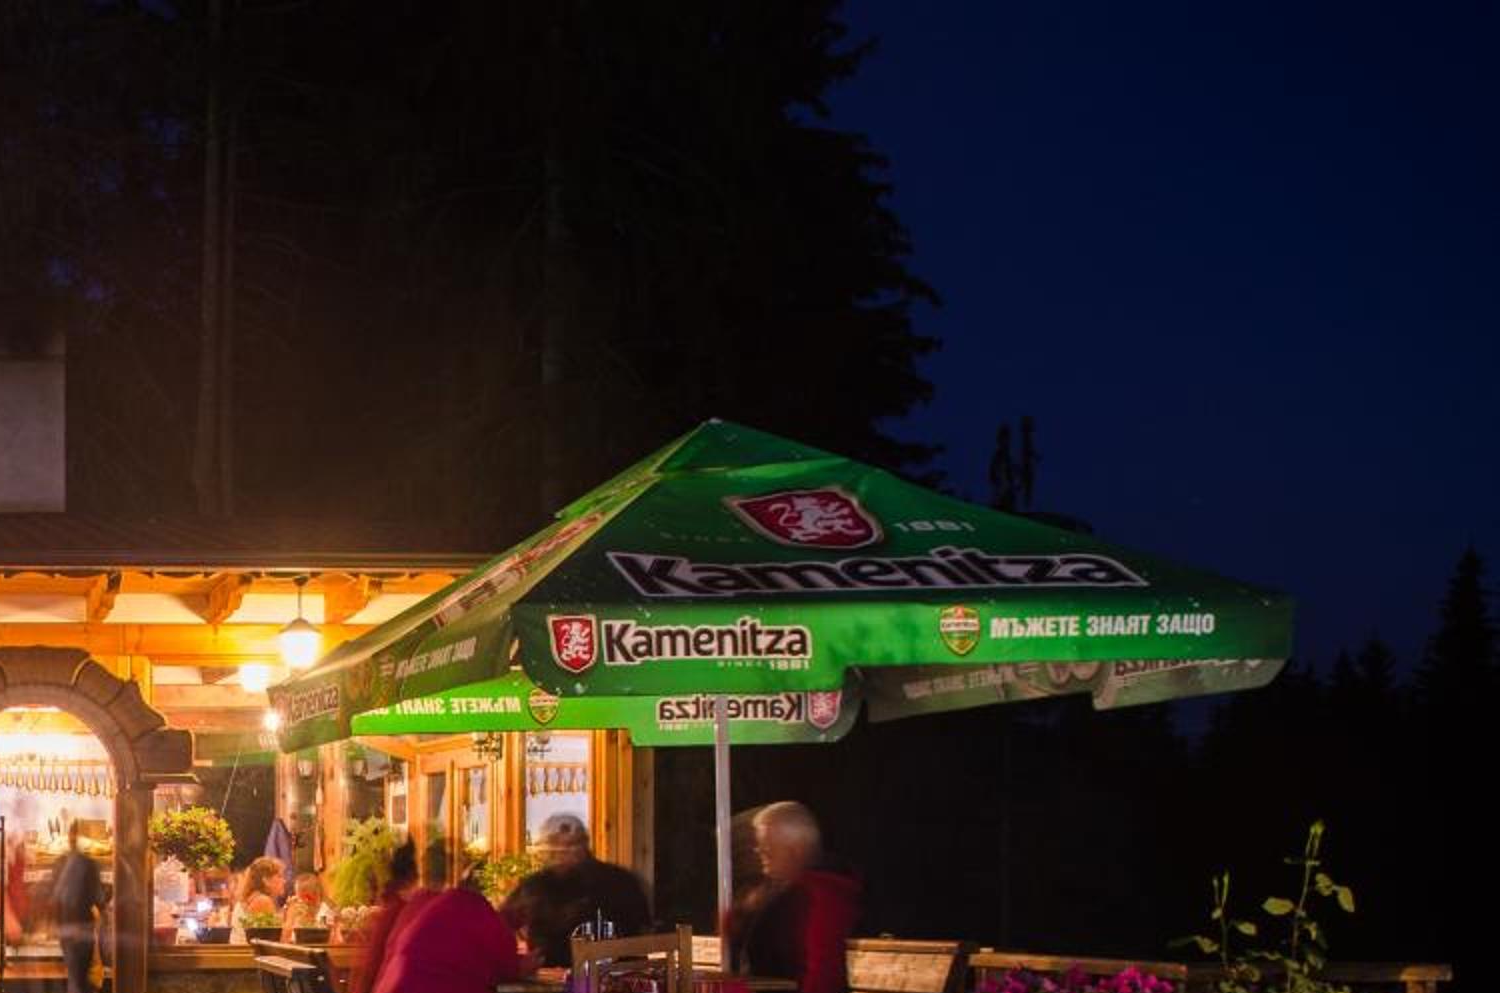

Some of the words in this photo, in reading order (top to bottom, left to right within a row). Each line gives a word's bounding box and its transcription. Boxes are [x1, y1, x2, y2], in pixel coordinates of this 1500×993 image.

[894, 520, 976, 532] 1881
[607, 546, 1148, 597] Kamenitza
[990, 616, 1080, 638] МЪЖЕТЕ
[1087, 614, 1151, 636] ЗНАЯТ
[1156, 613, 1215, 635] ЗАЩО
[602, 617, 811, 665] Kamenitza
[769, 660, 810, 671] 1881
